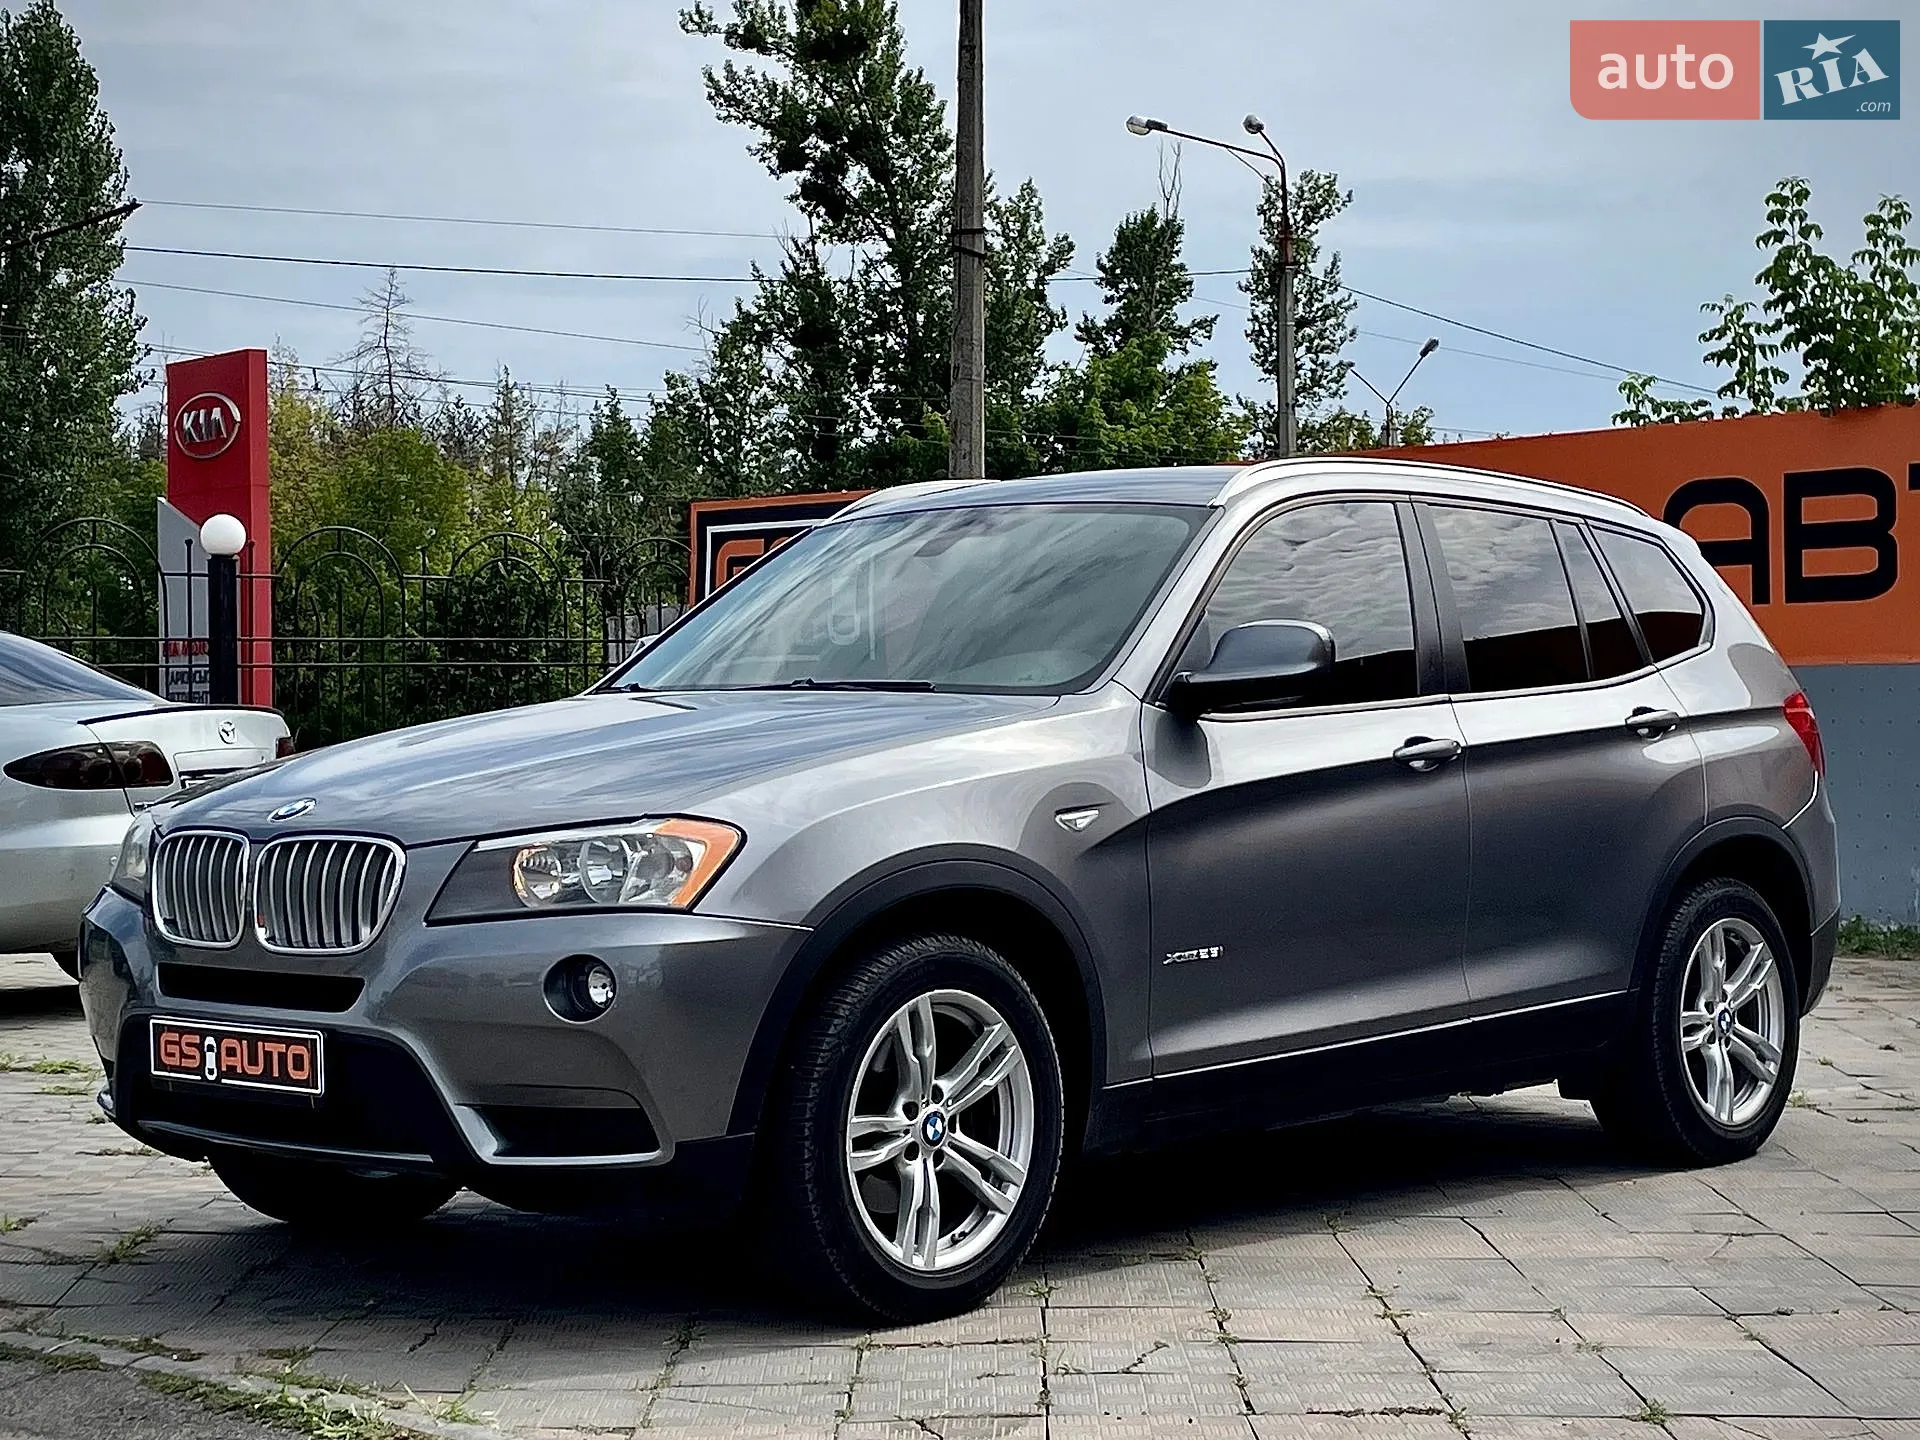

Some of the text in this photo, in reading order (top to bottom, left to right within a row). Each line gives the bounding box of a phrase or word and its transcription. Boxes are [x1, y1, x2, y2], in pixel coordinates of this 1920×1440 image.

[182, 407, 228, 443] KIA
[1662, 461, 1920, 606] АВ
[159, 1031, 310, 1081] GS AUTO
